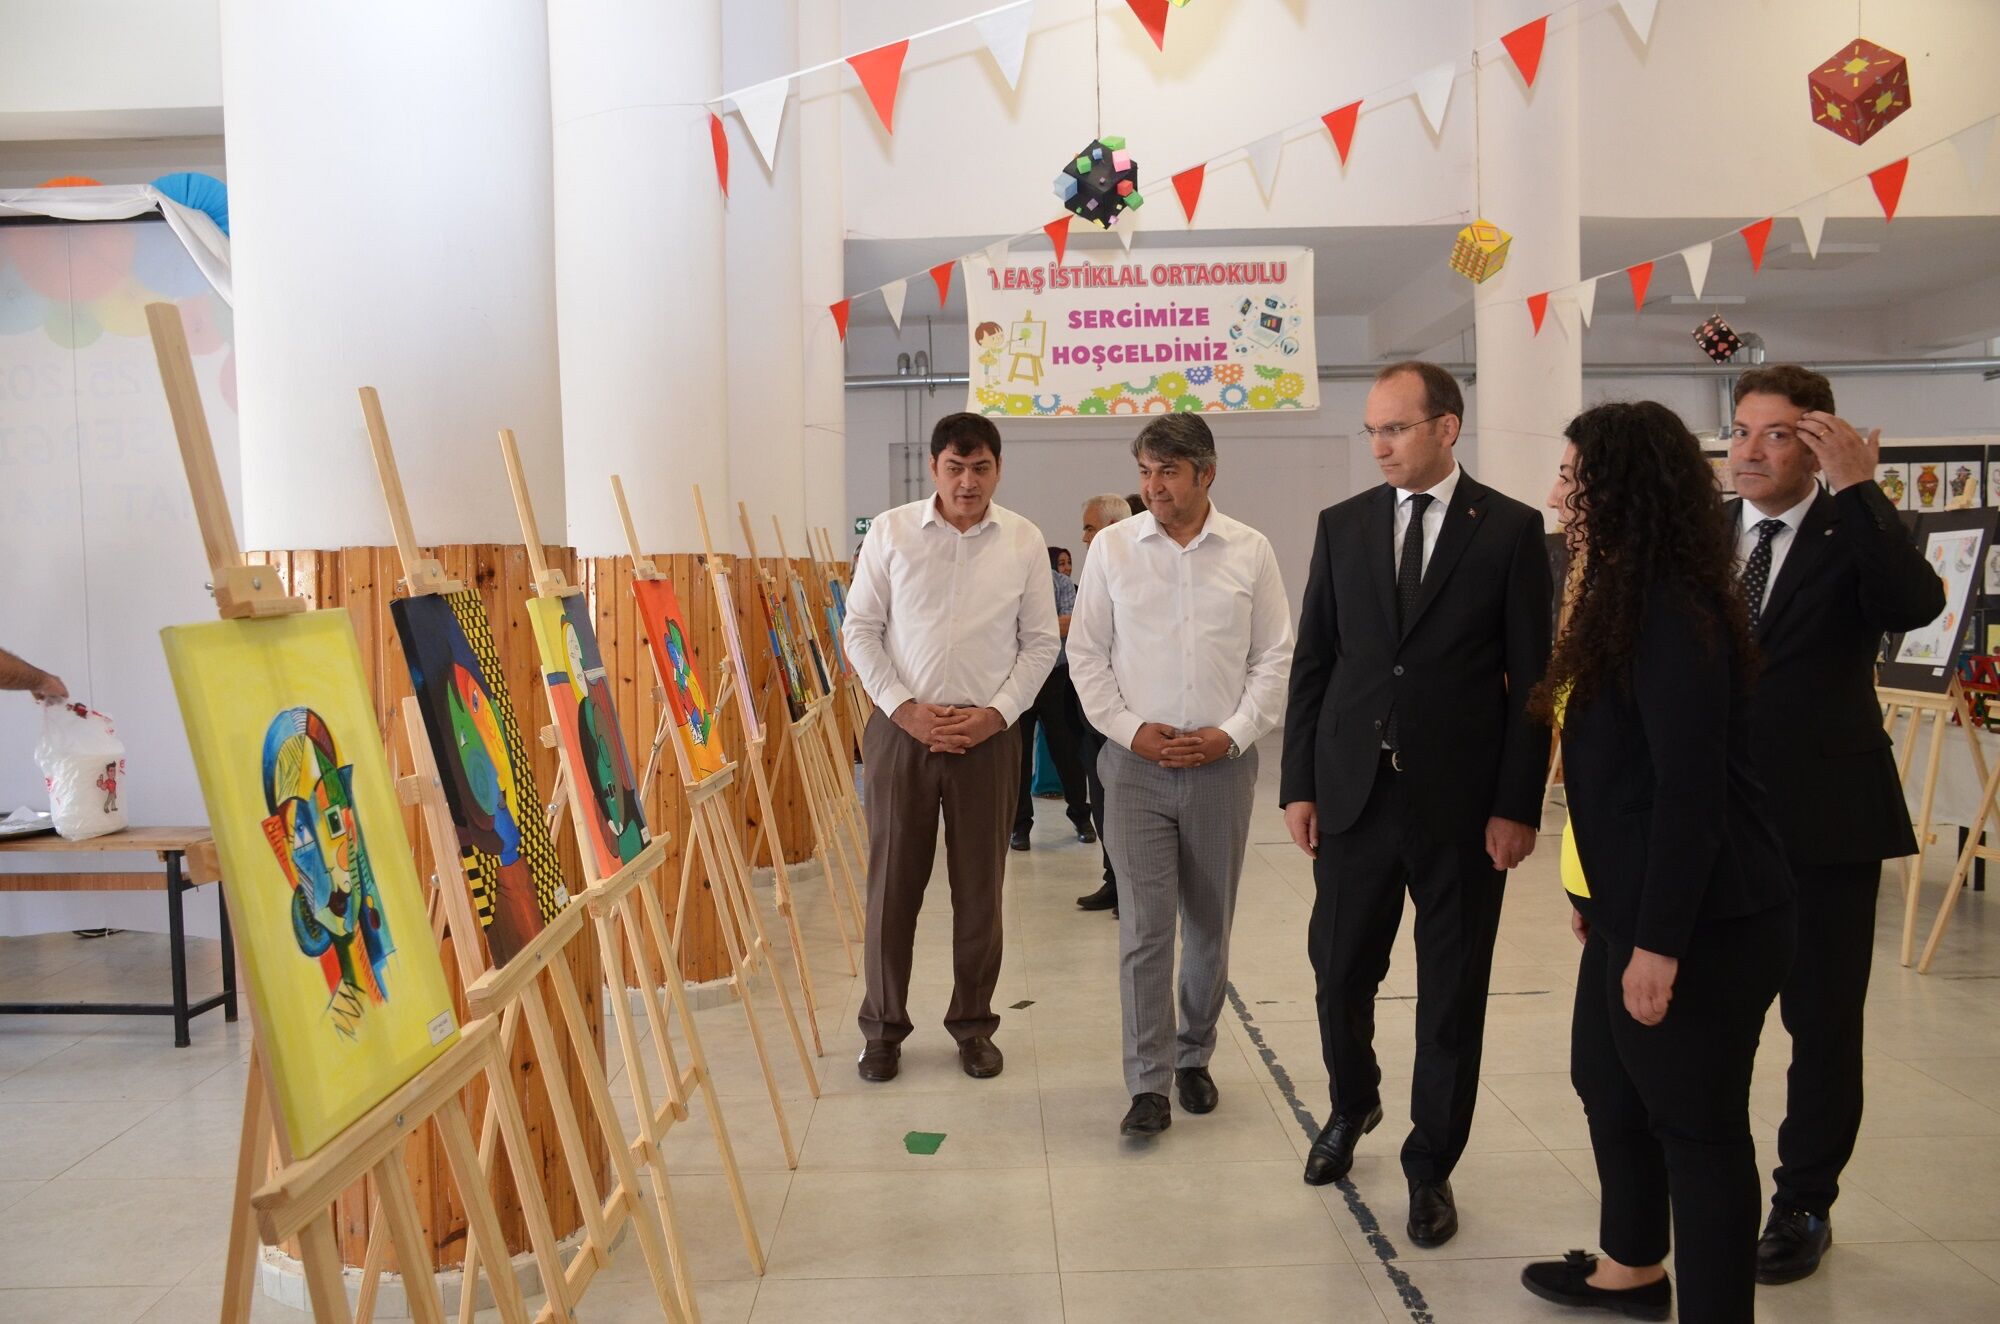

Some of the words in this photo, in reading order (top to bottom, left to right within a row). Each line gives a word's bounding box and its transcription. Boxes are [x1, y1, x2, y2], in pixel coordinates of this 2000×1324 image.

[1049, 261, 1149, 289] İSTİKLAL
[1150, 262, 1287, 287] ORTAOKULU
[1068, 302, 1210, 329] SERGİMİZE
[1052, 337, 1228, 371] HOŞGELDİNİZ
